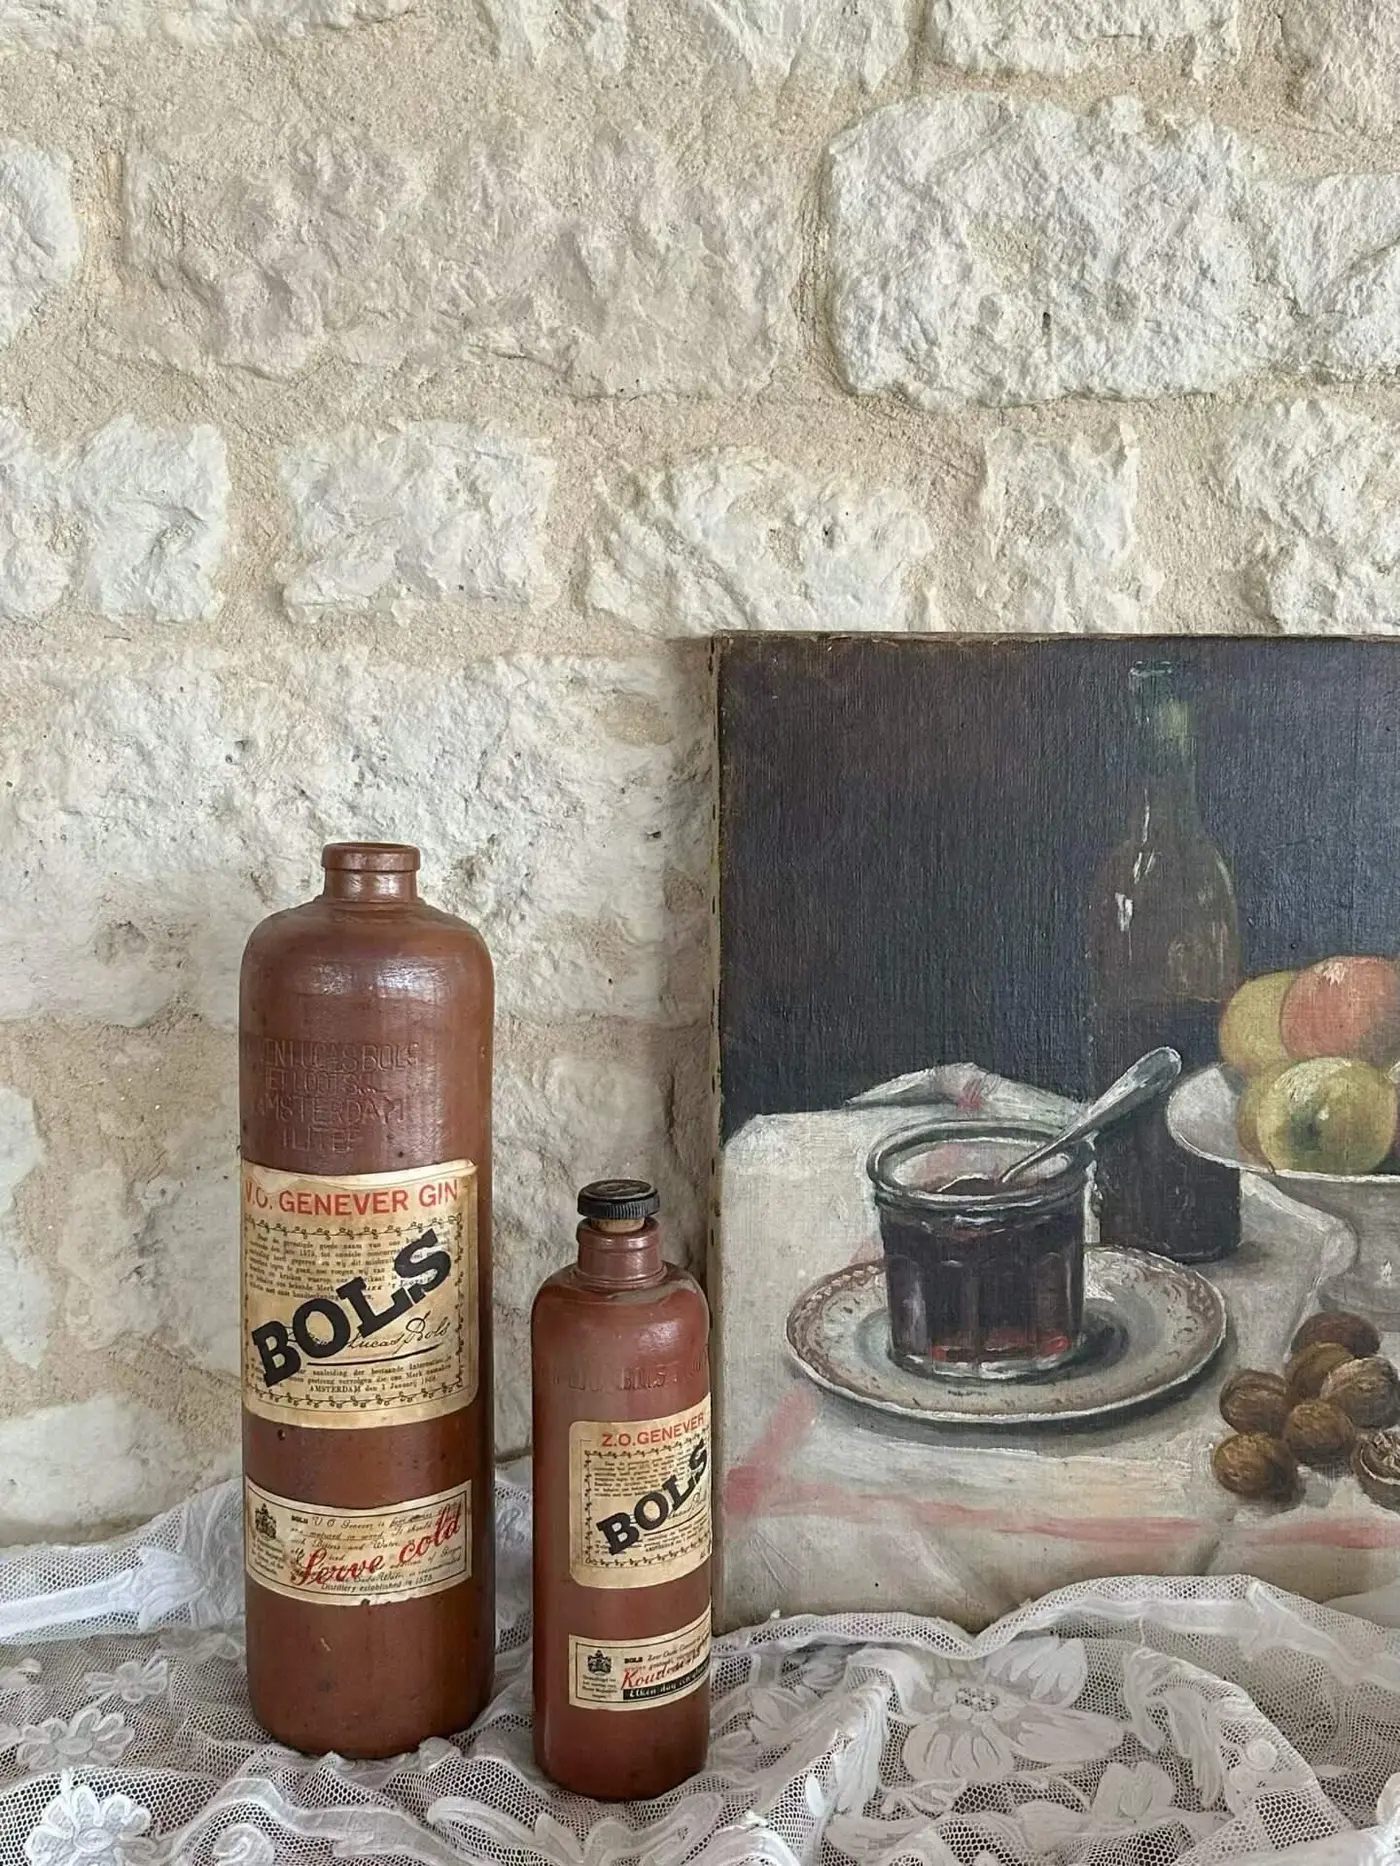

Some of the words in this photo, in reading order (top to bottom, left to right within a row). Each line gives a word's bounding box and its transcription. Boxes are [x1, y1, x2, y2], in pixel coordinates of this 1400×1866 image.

[279, 1189, 410, 1216] GENEVER
[418, 1179, 459, 1208] GIN
[251, 1228, 452, 1387] BOLS
[290, 1547, 386, 1586] Serve
[398, 1501, 462, 1564] cold
[595, 1437, 708, 1556] BOLS
